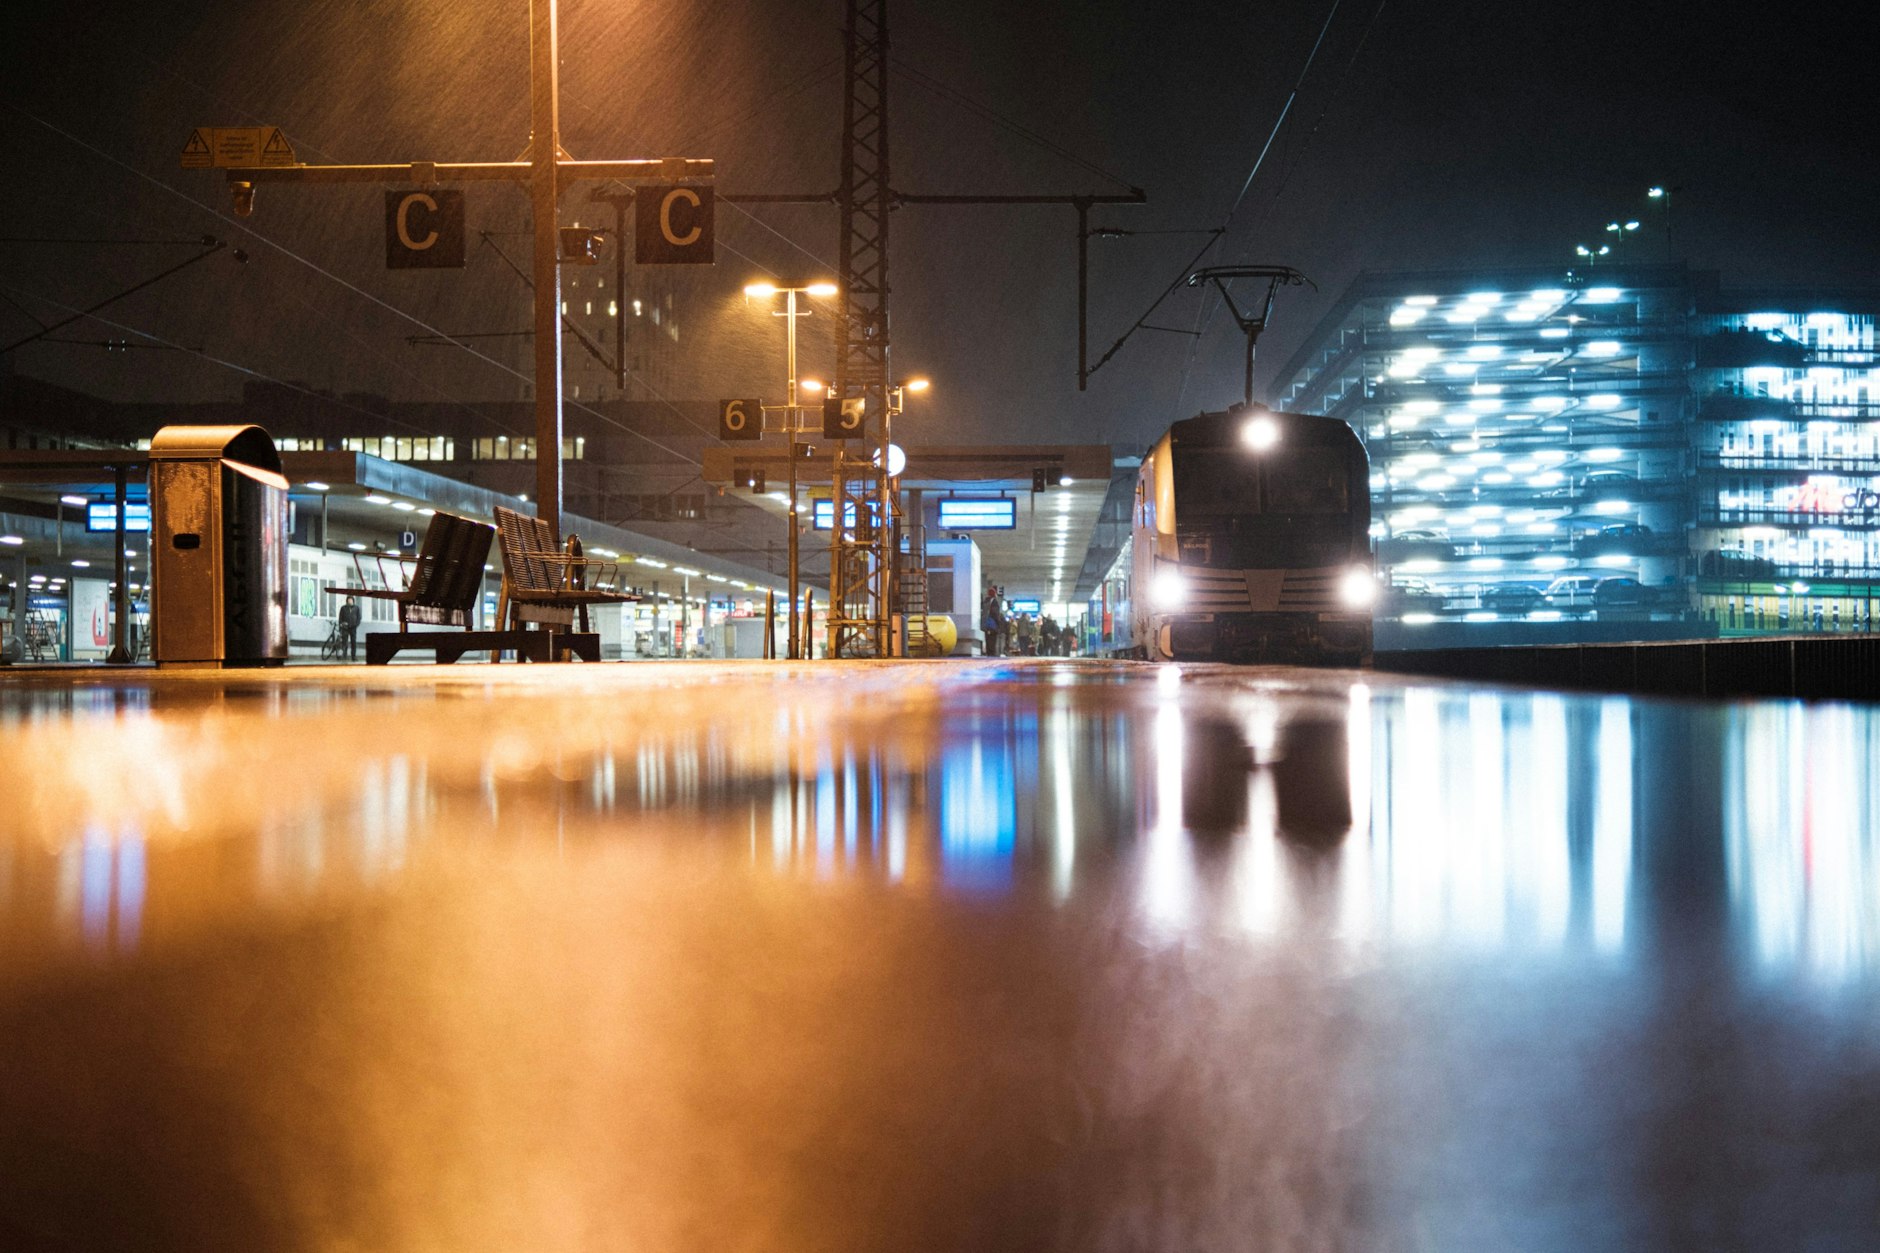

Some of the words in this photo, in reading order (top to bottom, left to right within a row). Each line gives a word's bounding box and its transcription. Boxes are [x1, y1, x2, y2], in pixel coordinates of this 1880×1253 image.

[396, 192, 439, 251] C
[659, 188, 701, 246] C
[725, 400, 746, 431] 6
[840, 399, 865, 430] 5
[1787, 481, 1880, 513] Mdia
[403, 532, 414, 546] D
